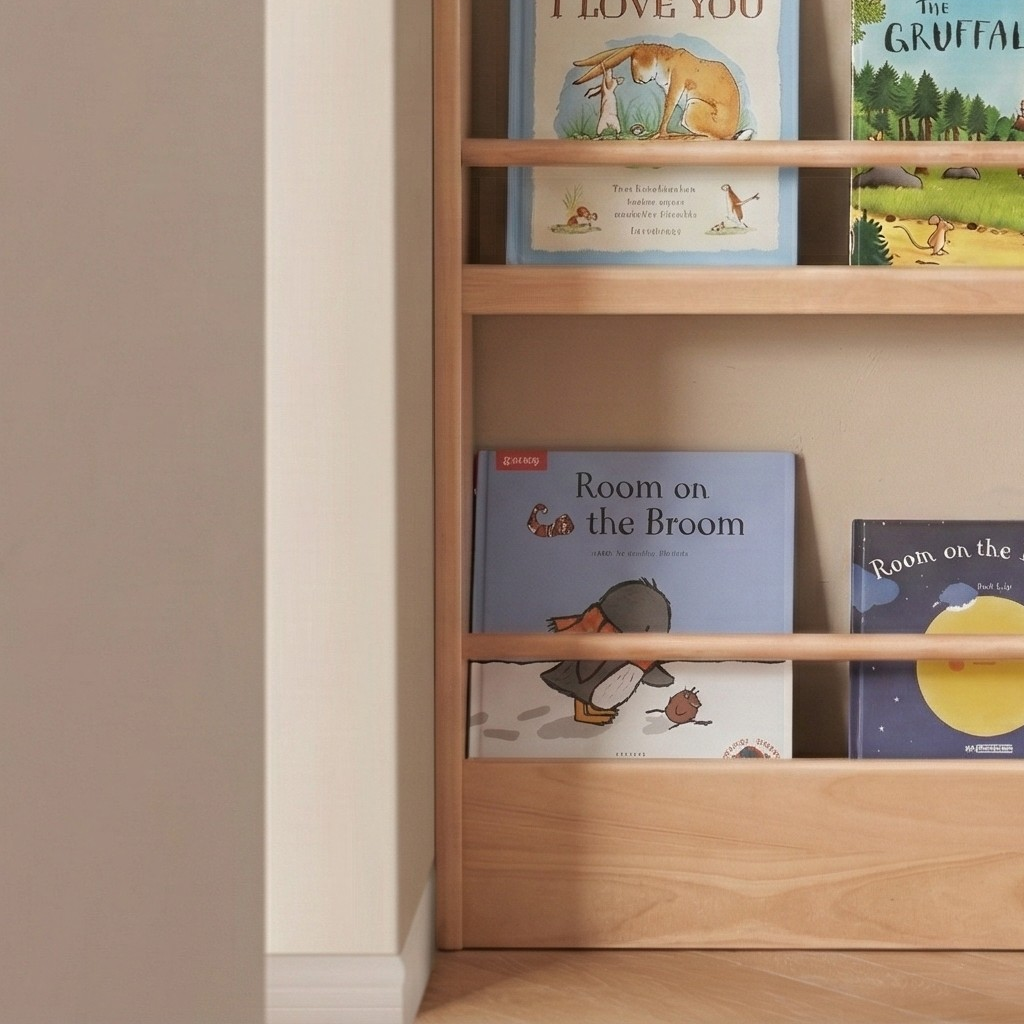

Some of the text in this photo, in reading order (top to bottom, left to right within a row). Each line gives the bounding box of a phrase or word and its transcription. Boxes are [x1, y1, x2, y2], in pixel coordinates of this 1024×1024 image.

[576, 472, 710, 499] Room on
[586, 507, 745, 536] the Broom
[868, 551, 936, 580] Room
[944, 545, 972, 559] on
[976, 538, 1011, 560] the
